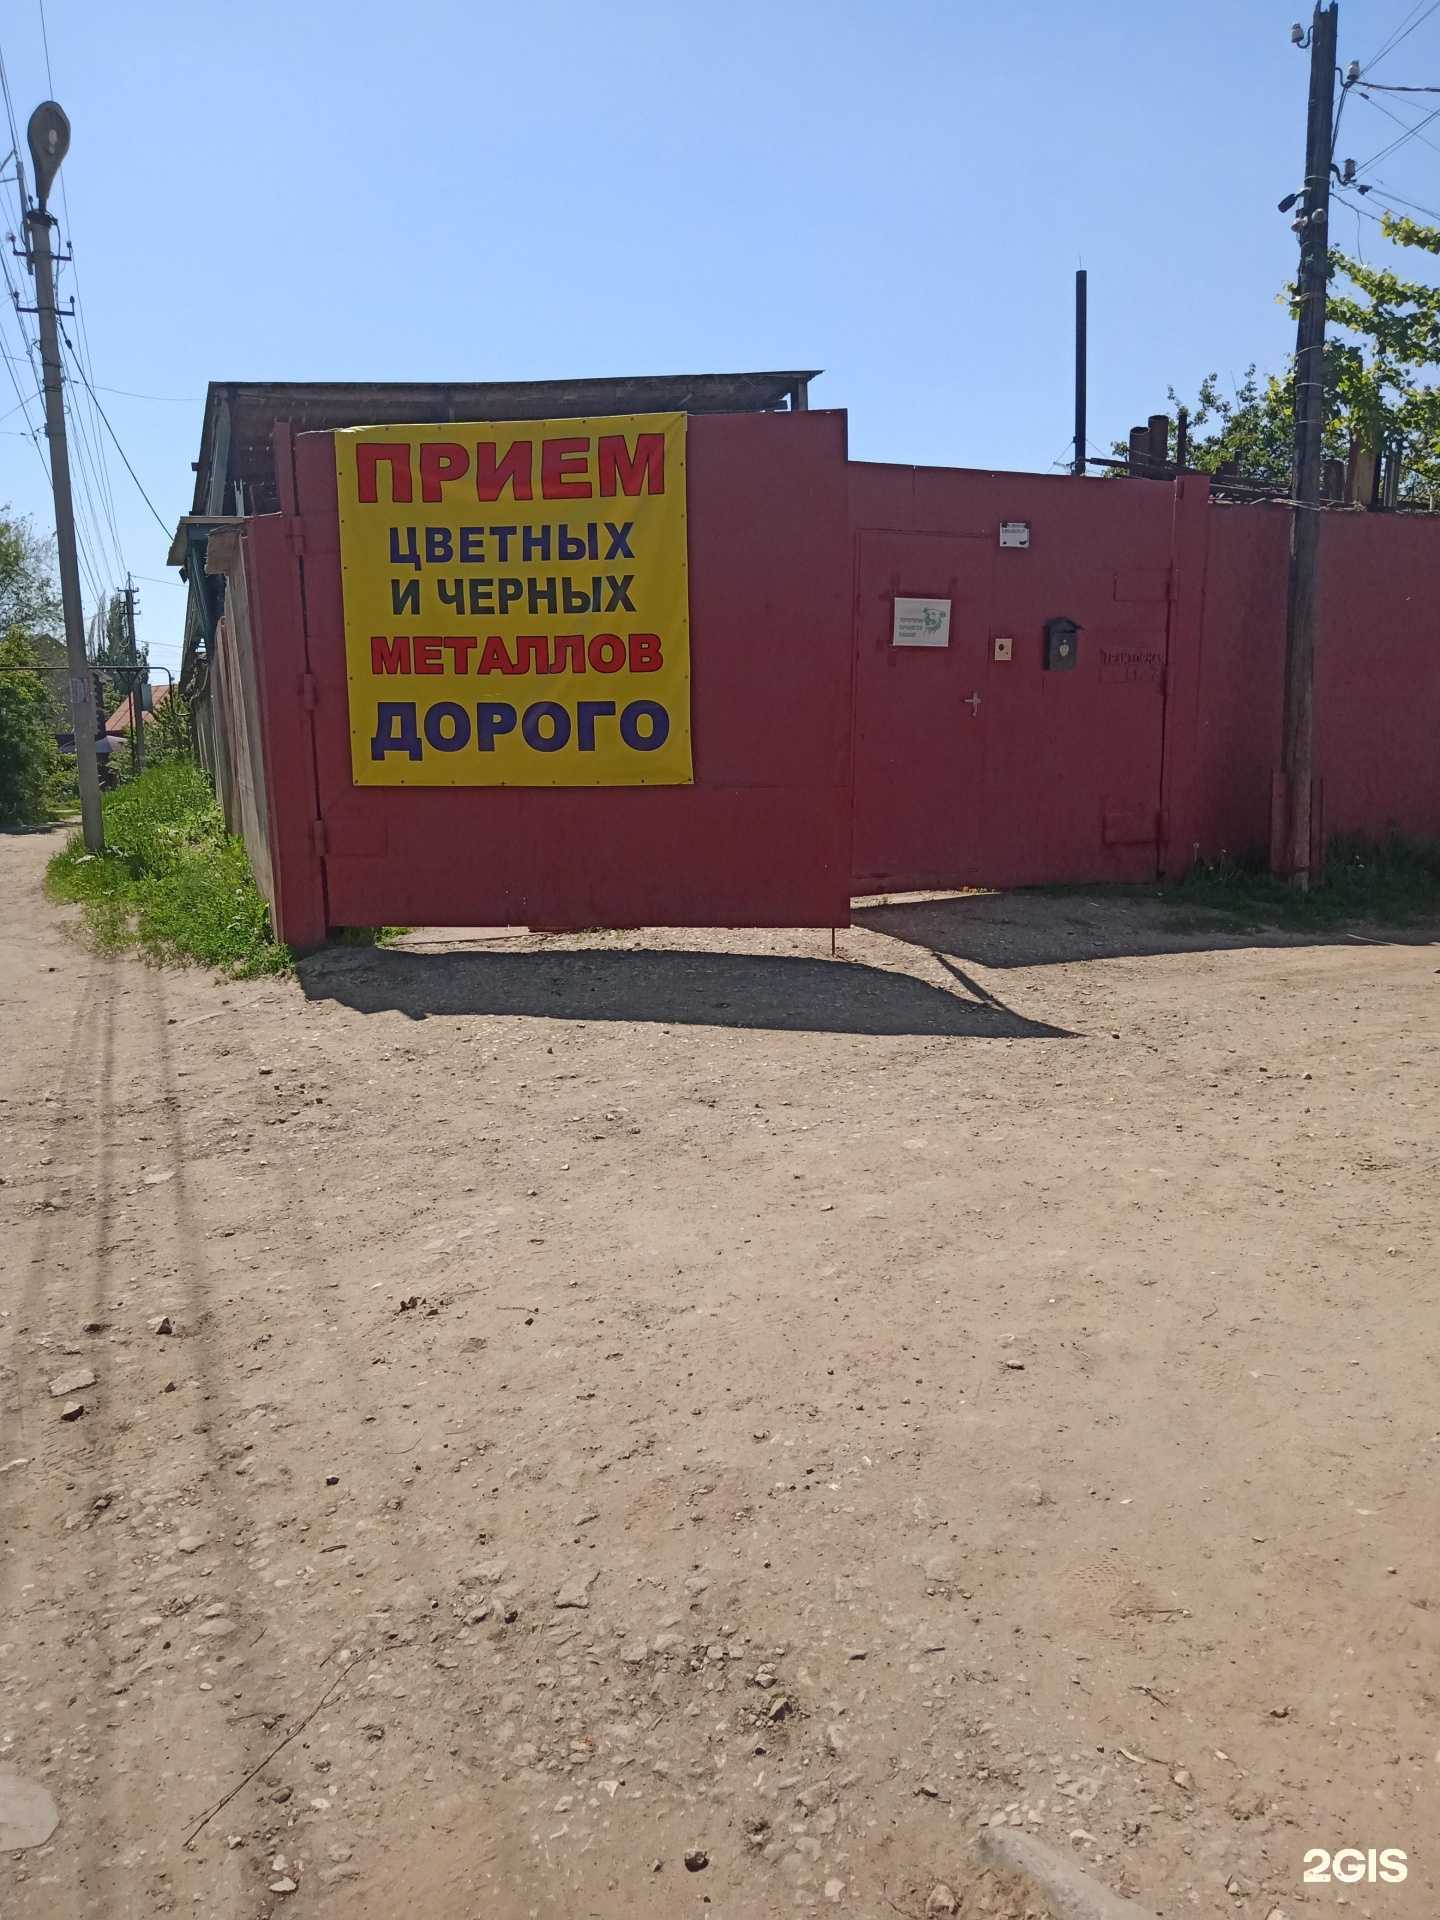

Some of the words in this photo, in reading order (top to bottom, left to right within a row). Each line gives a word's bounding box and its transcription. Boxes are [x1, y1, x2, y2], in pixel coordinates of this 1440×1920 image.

[356, 433, 665, 503] ПРИЕМ
[389, 522, 635, 571] ЦВЕТНЫХ
[391, 579, 421, 615] И
[437, 575, 637, 615] ЧЕРНЫХ
[370, 633, 664, 676] МЕТАЛЛОВ
[370, 699, 670, 761] ДОРОГО
